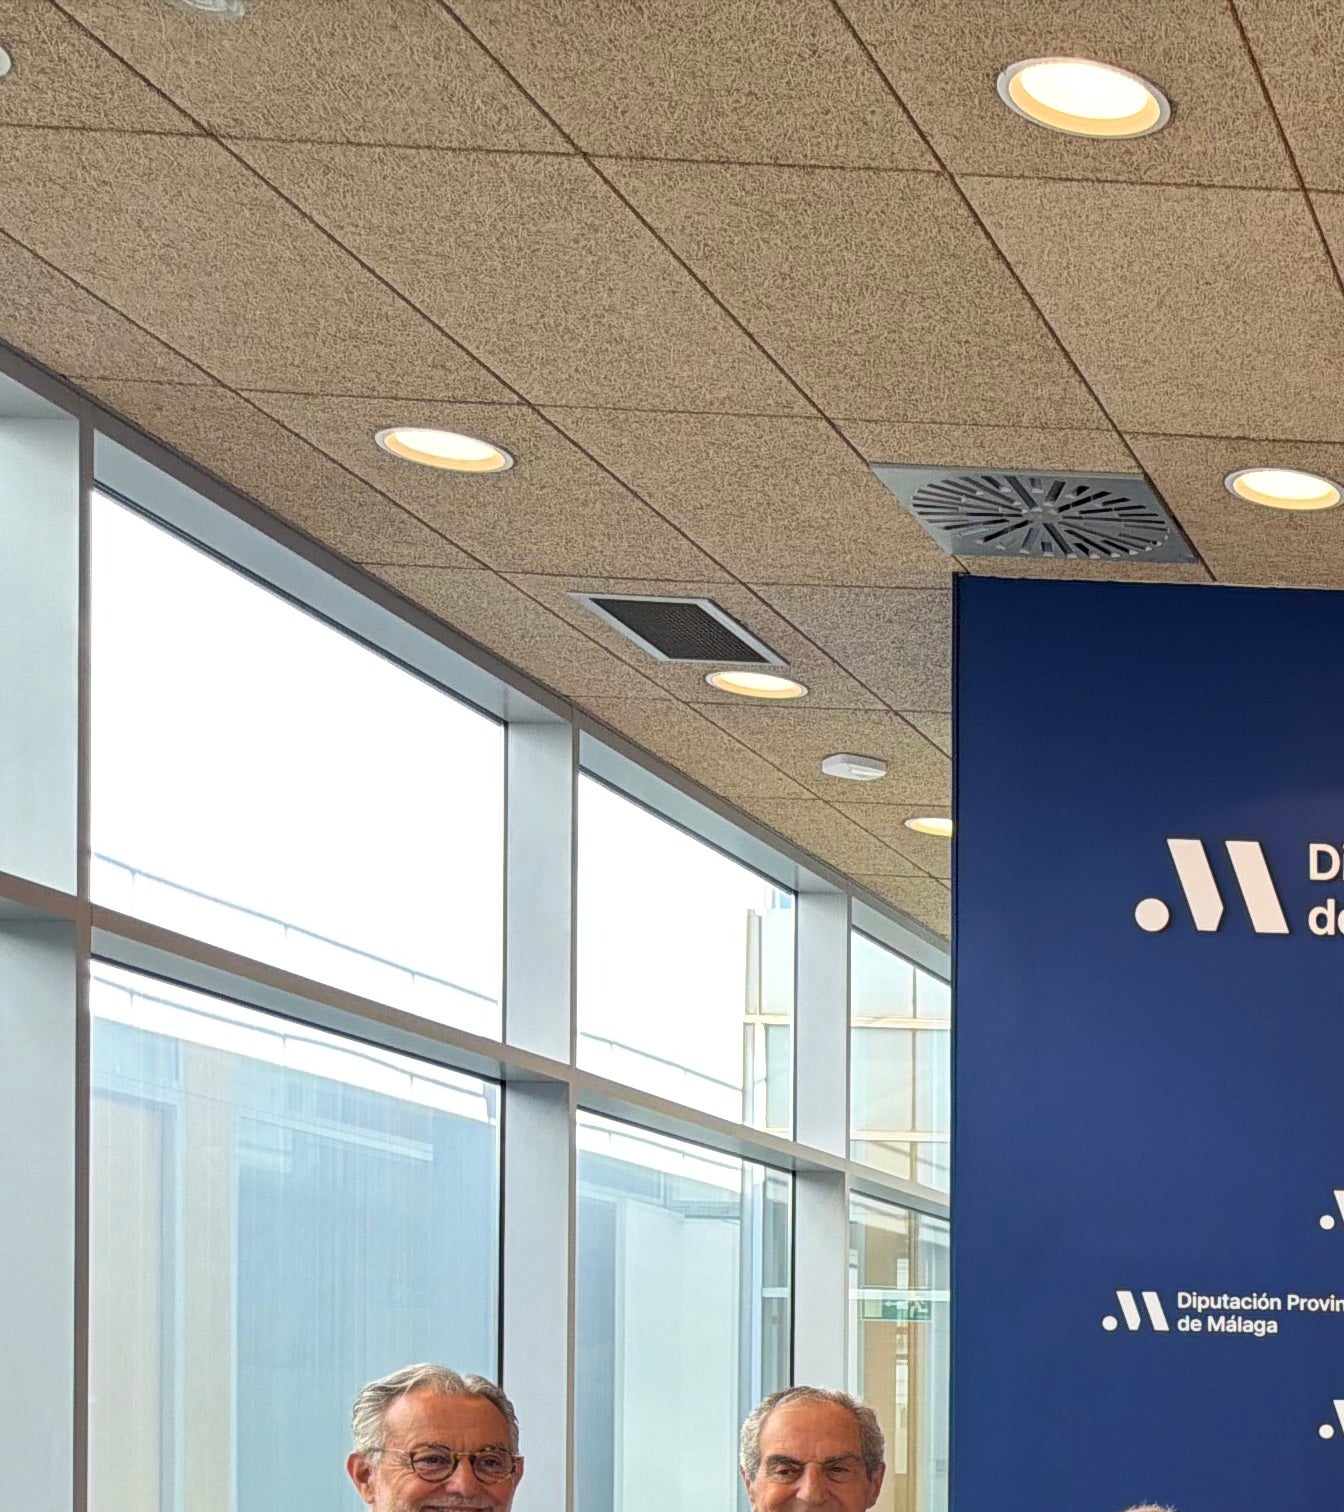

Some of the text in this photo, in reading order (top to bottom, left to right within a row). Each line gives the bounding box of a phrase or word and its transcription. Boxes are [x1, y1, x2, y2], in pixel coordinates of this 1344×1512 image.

[1177, 1291, 1281, 1313] Diputación
[1177, 1314, 1278, 1337] de Málaga
